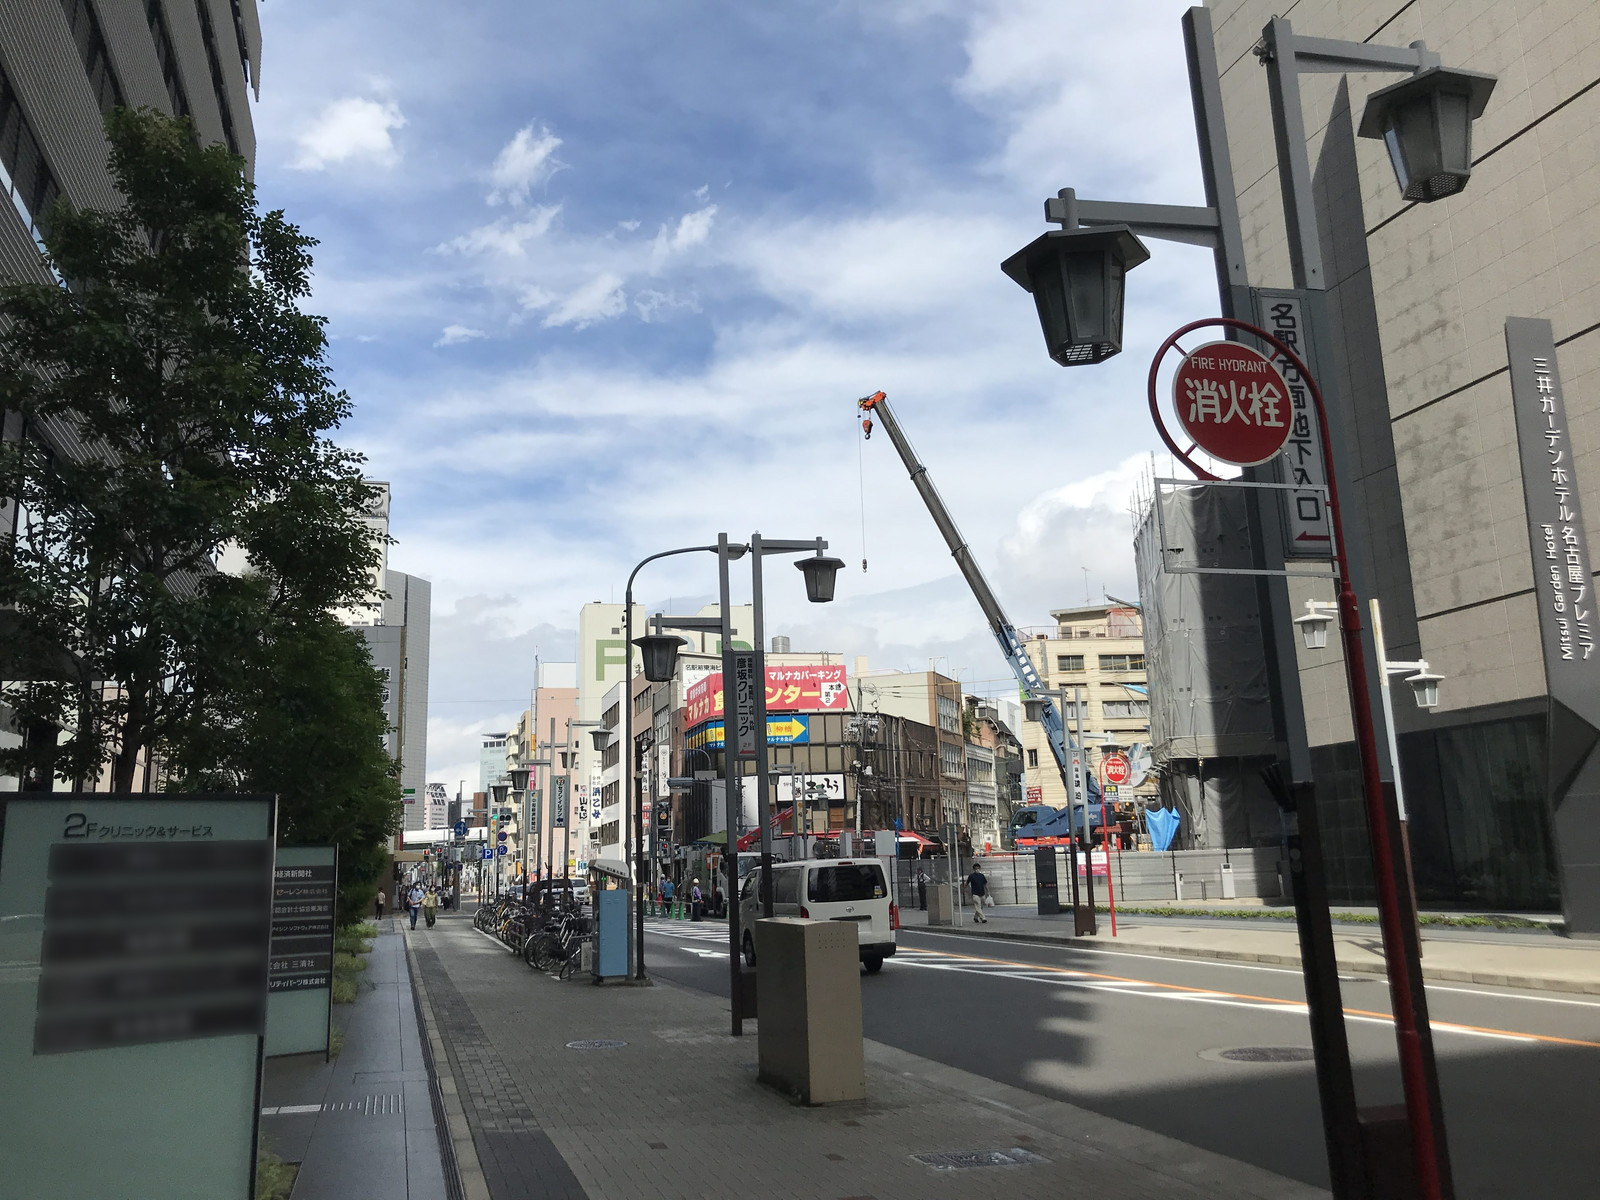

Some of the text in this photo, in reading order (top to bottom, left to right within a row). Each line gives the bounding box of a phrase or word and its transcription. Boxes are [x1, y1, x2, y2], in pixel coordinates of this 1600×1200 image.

[1191, 356, 1268, 373] FIRE HYDRANT
[1185, 378, 1285, 427] 消火栓
[1540, 524, 1574, 660] Mitsui Garden Hotel
[737, 657, 749, 737] 彦坂クリニック
[1106, 766, 1125, 775] 消火栓
